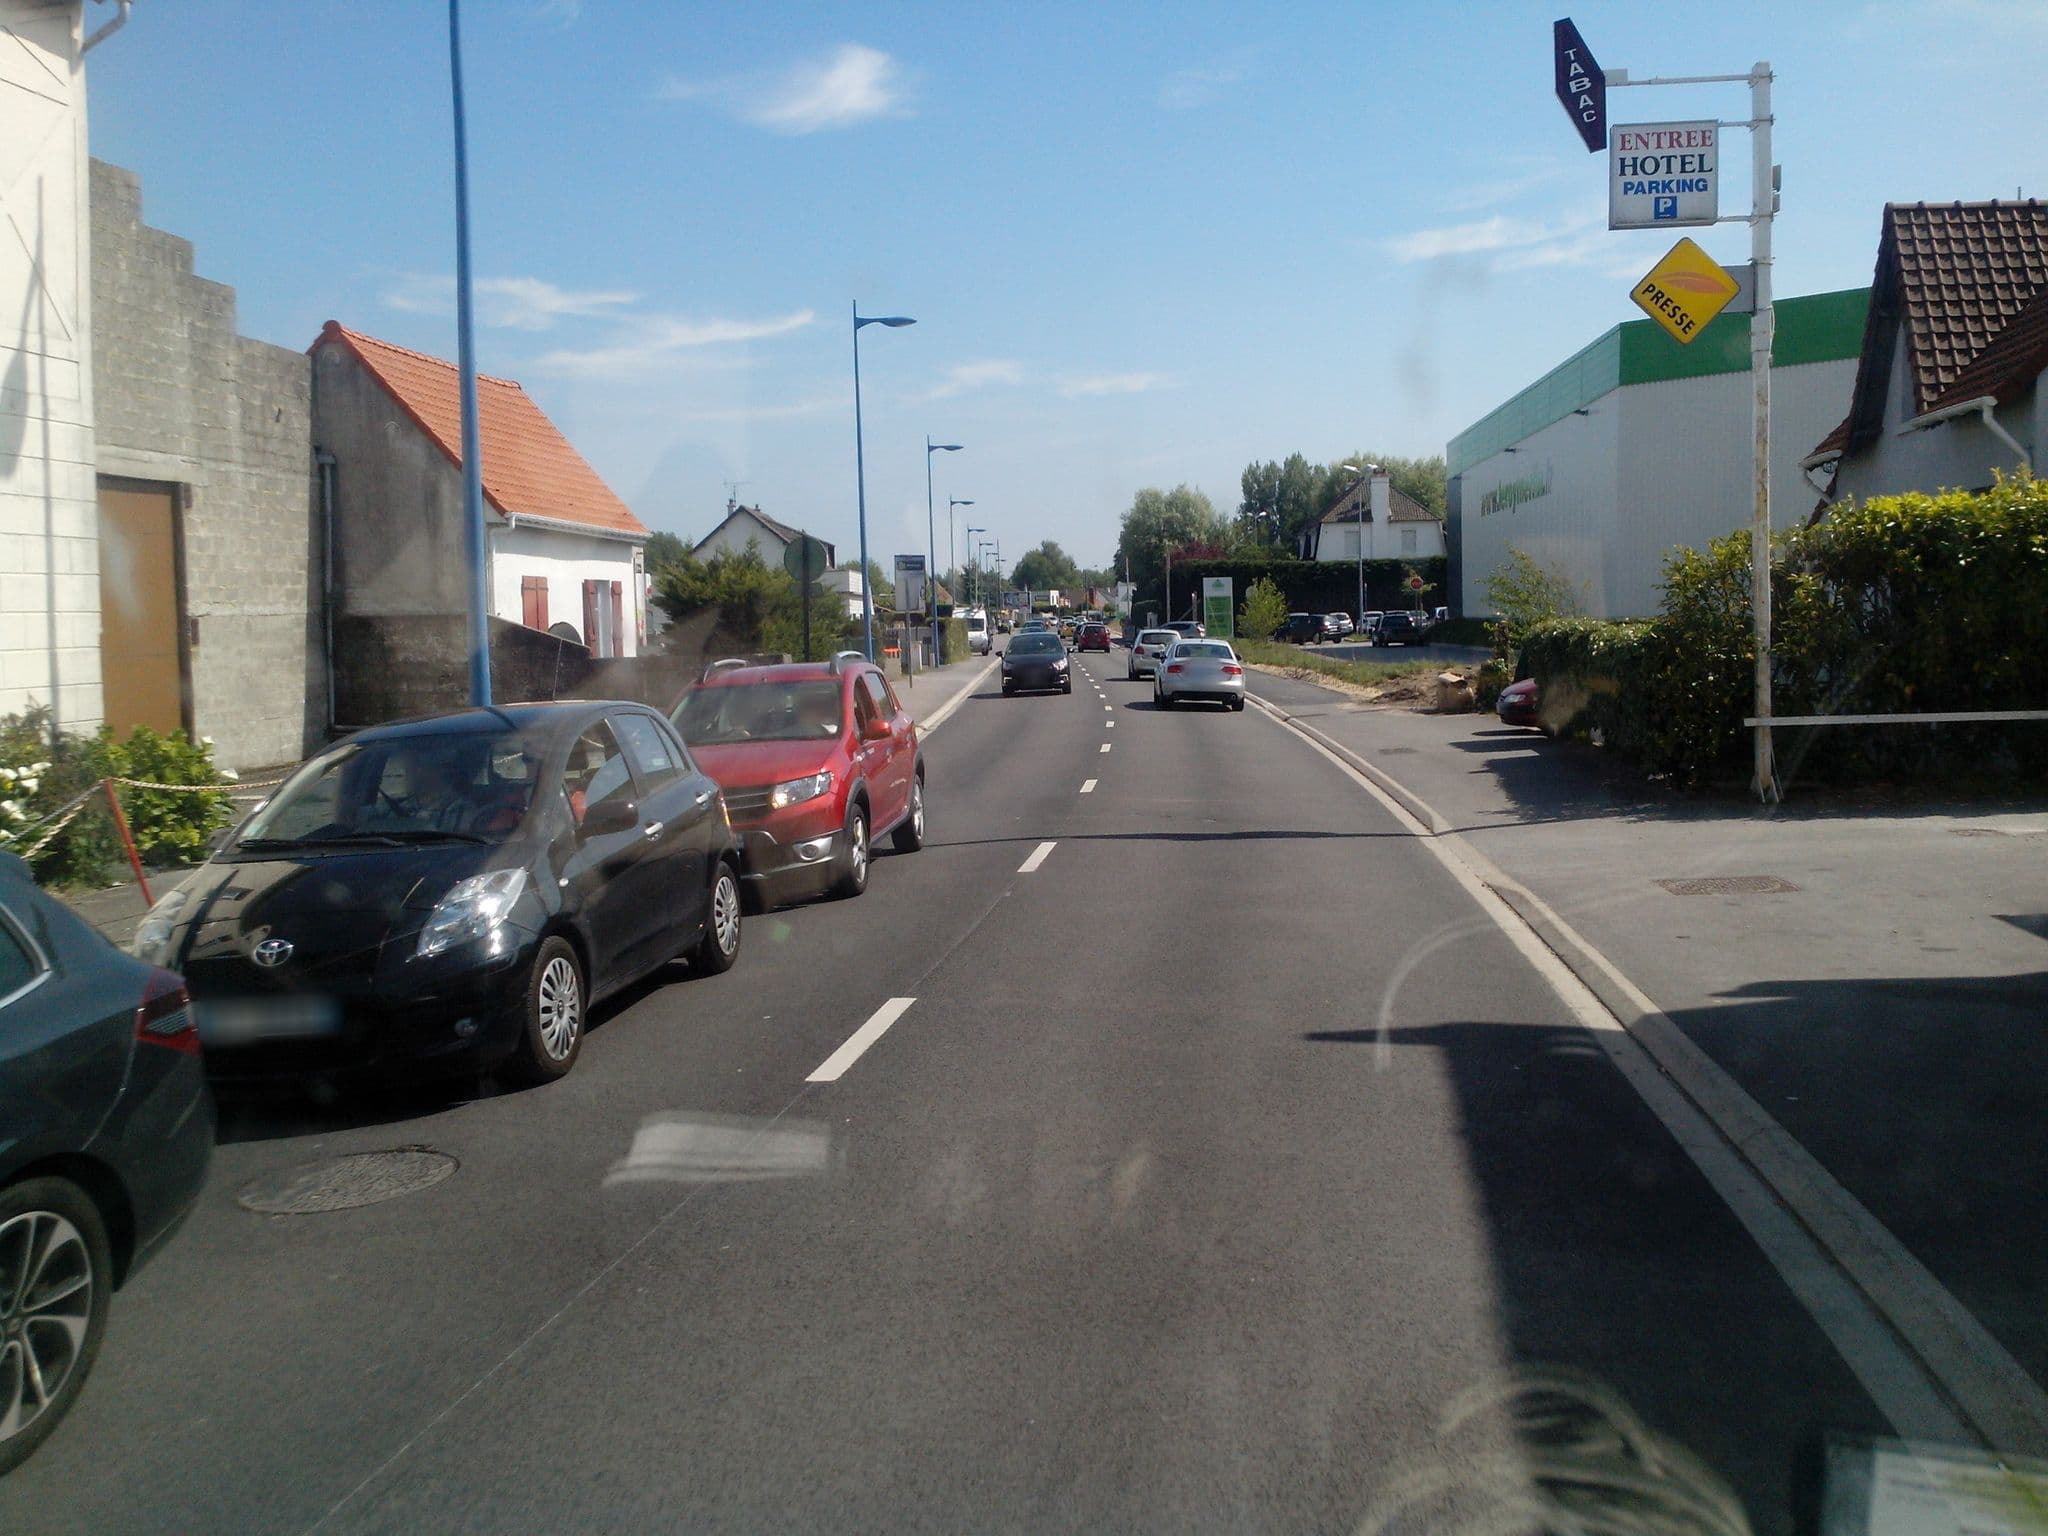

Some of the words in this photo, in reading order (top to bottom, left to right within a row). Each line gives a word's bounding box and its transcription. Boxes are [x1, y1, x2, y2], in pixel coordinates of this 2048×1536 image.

[1564, 48, 1597, 122] TABAC
[1620, 130, 1713, 151] ENTREE
[1618, 154, 1713, 176] HOTEL
[1623, 178, 1708, 195] PARKING
[1659, 198, 1672, 213] P
[1641, 283, 1696, 335] PRESSE
